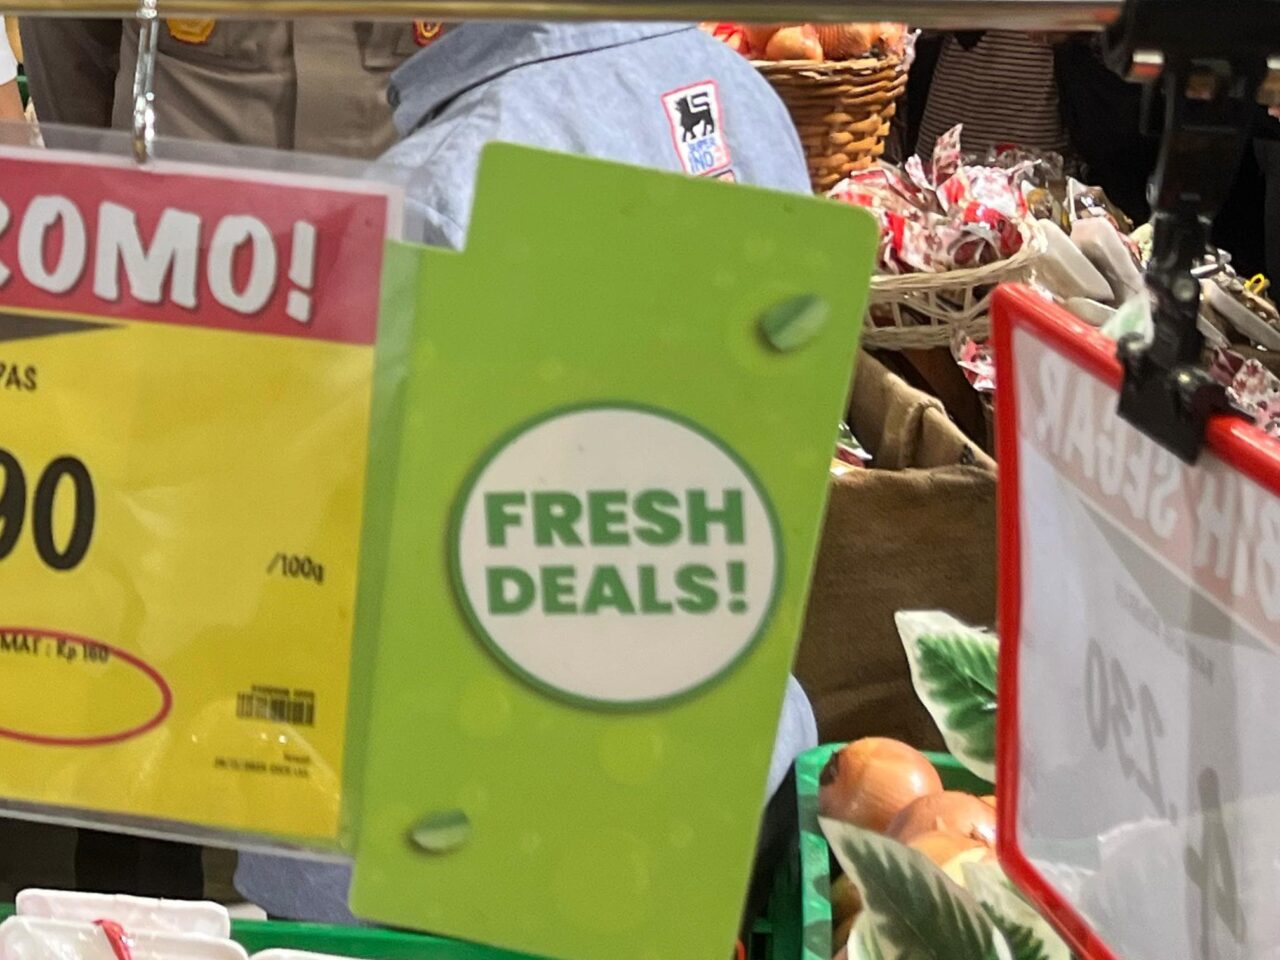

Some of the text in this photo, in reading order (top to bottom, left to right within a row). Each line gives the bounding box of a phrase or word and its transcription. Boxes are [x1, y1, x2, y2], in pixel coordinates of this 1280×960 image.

[484, 488, 746, 547] FRESH
[267, 553, 324, 585] /100g
[486, 560, 748, 615] DEALS!
